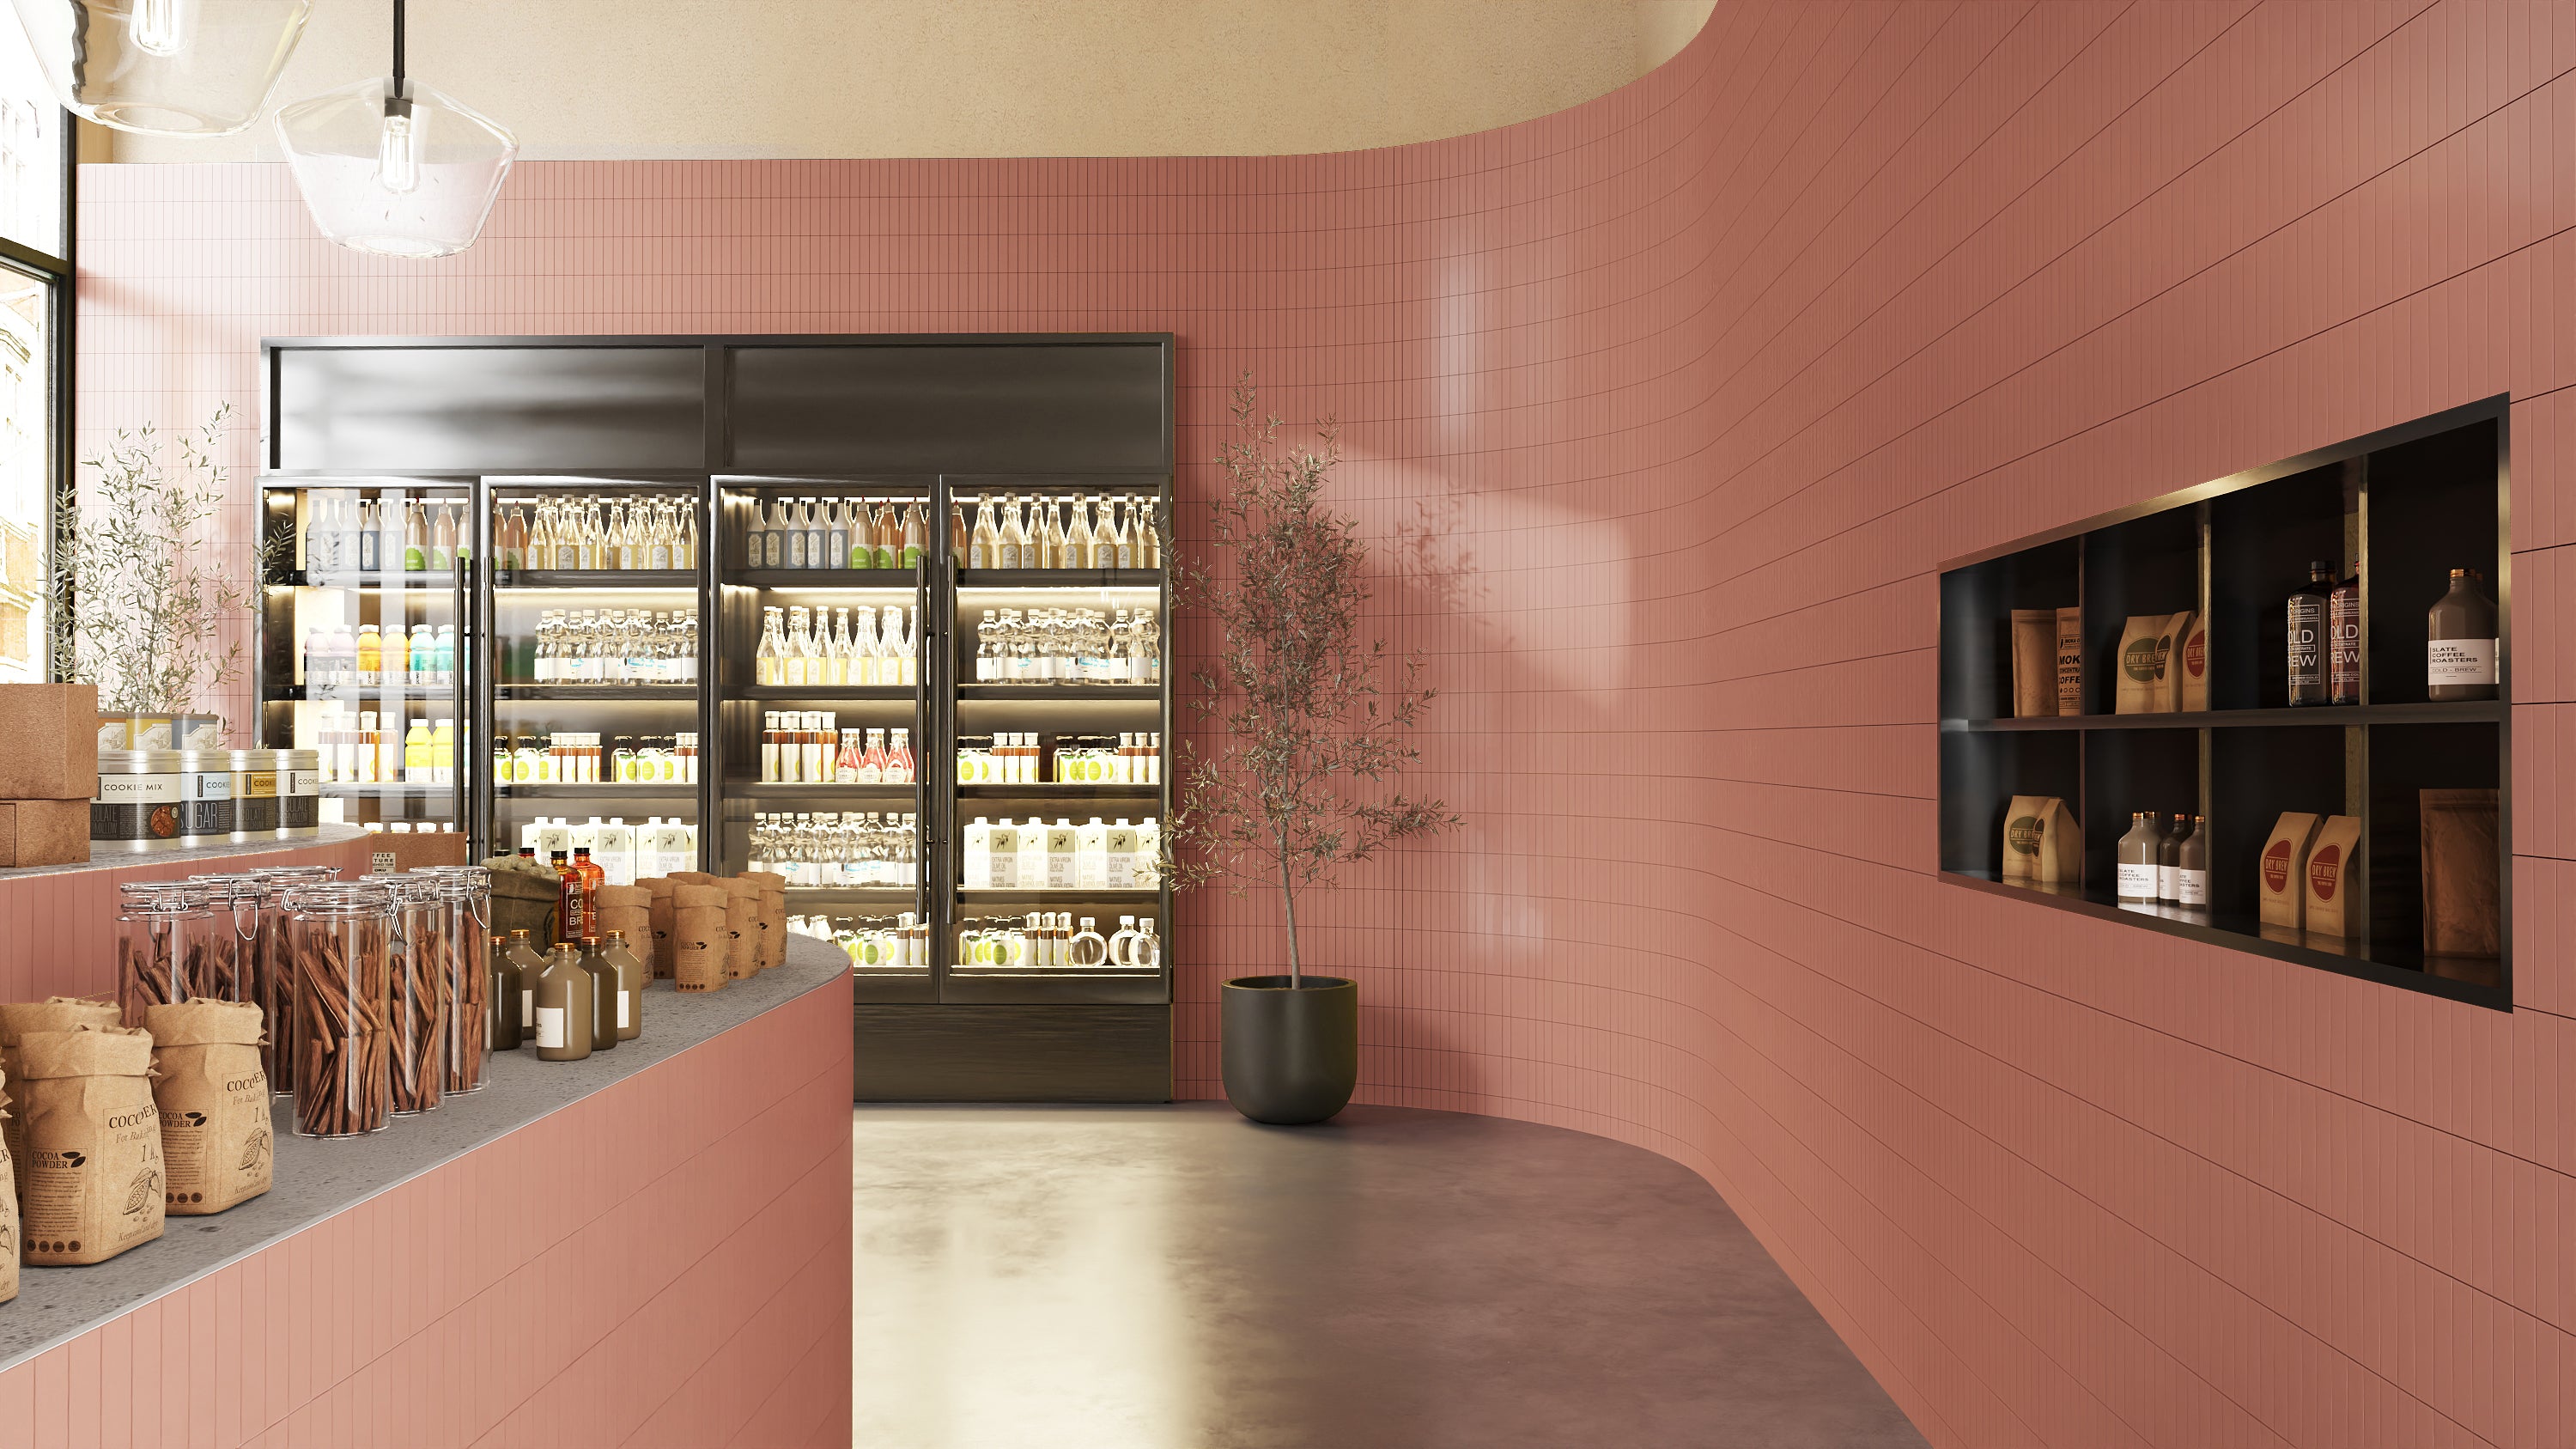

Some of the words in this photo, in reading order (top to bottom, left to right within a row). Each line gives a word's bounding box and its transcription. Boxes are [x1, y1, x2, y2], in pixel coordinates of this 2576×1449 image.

[2288, 630, 2313, 643] OLD
[2331, 624, 2358, 639] OLD
[2059, 655, 2080, 665] MOK
[2126, 654, 2140, 664] DRY
[2142, 654, 2155, 663] BRE
[2288, 654, 2317, 667] REW
[2331, 651, 2360, 663] REW
[2266, 859, 2275, 869] DRY
[2275, 860, 2287, 871] BREW
[2312, 865, 2322, 875] DRY
[2324, 866, 2336, 878] BREW
[570, 899, 583, 909] CO
[116, 1133, 128, 1143] For
[32, 1151, 58, 1160] COCOA
[142, 1143, 146, 1162] 1
